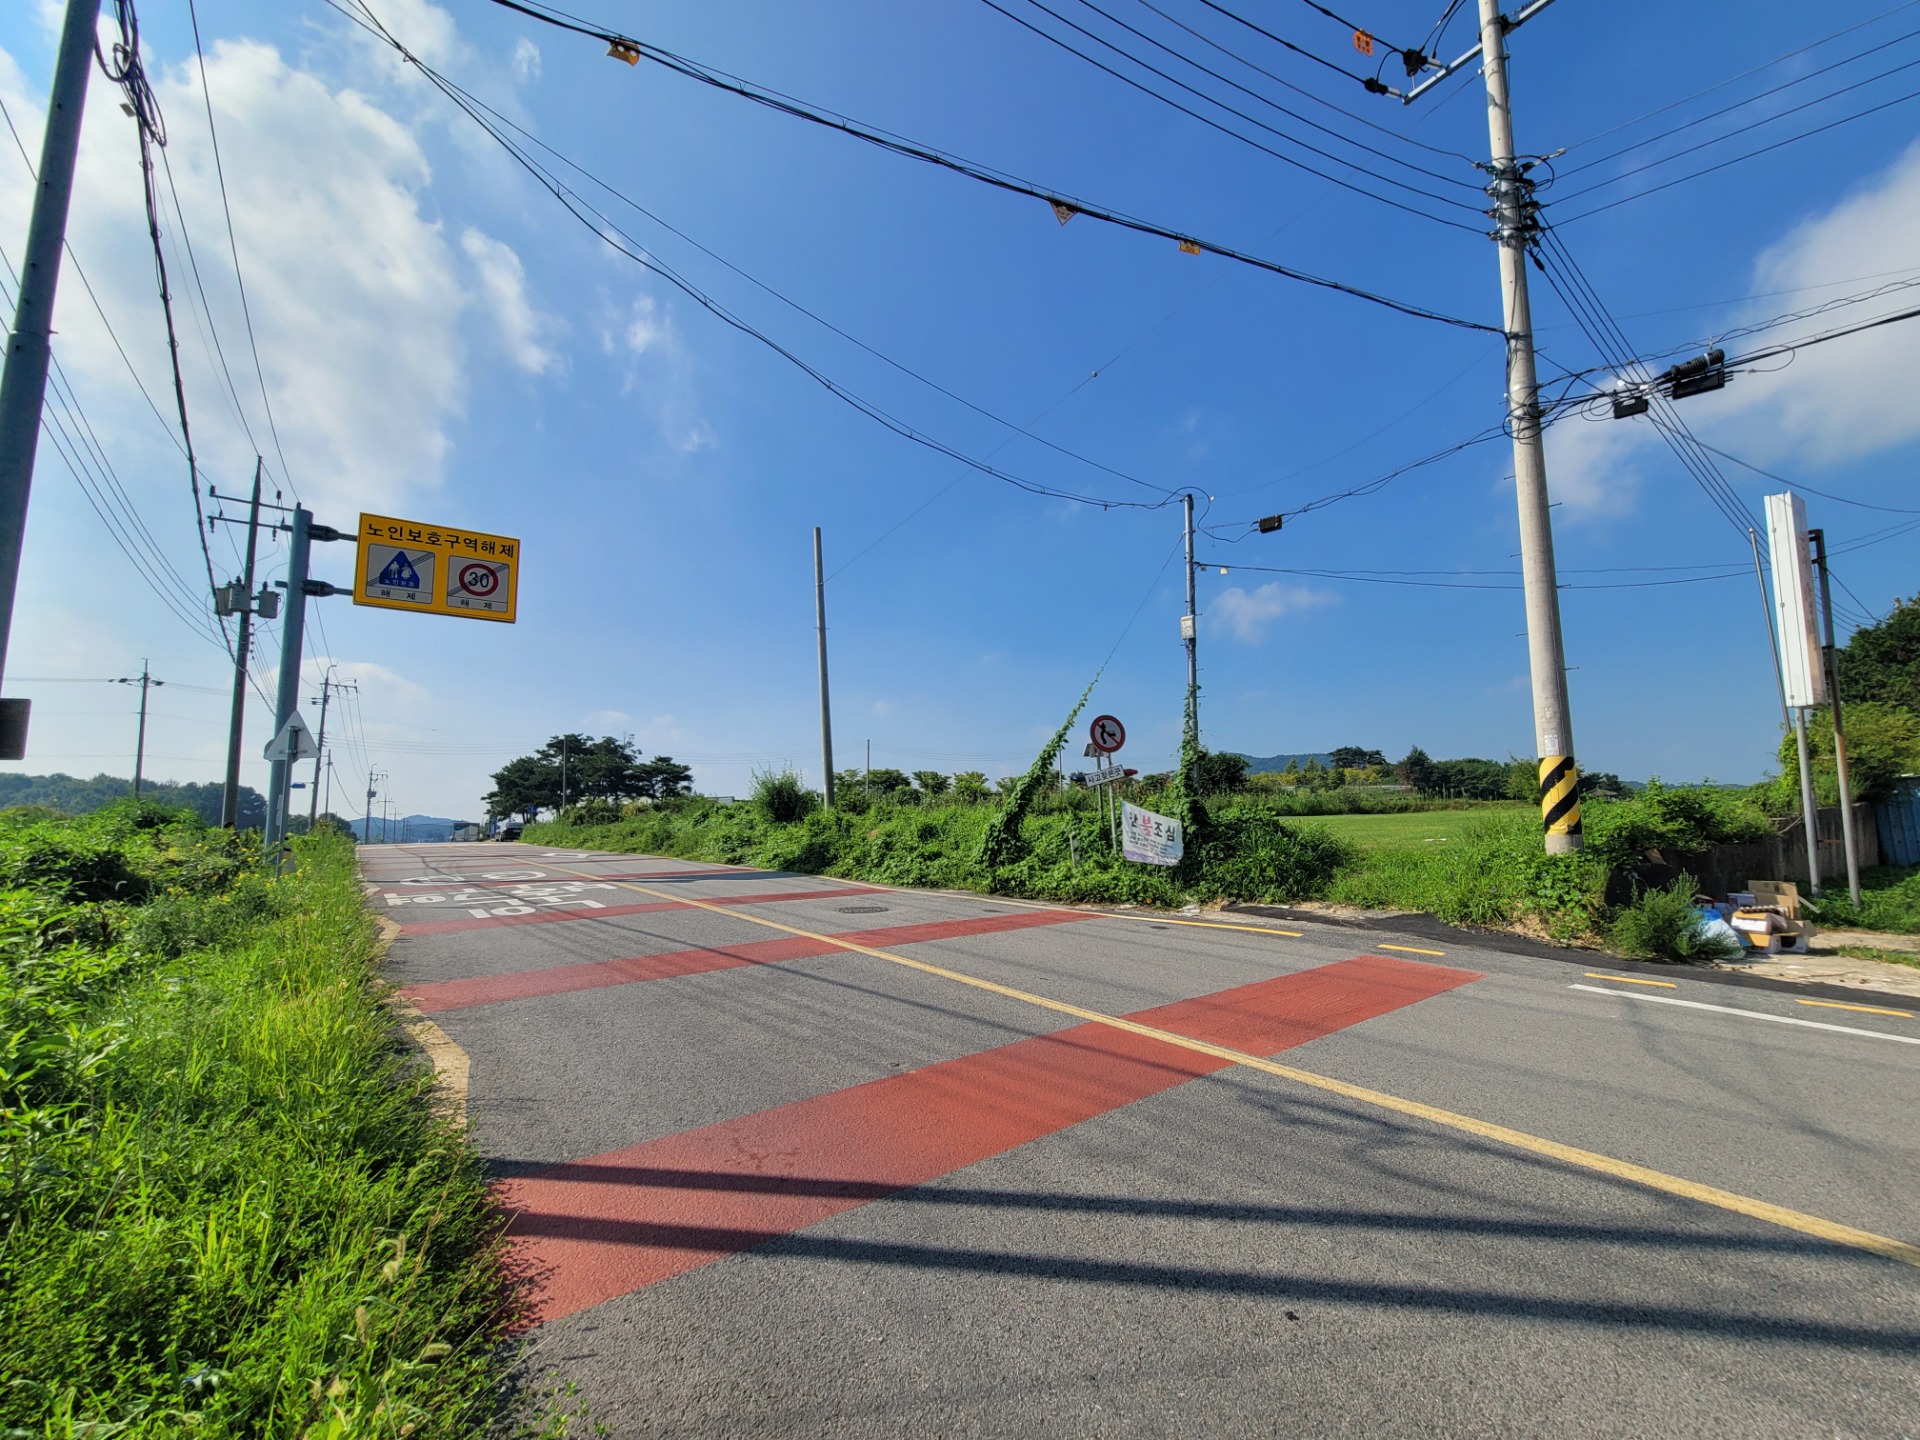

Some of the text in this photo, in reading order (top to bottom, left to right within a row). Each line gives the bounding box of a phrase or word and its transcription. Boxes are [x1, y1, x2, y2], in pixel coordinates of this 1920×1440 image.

[365, 523, 514, 558] 노인보호구역해제
[468, 571, 490, 588] 30
[1088, 767, 1121, 783] 사고잦은곳
